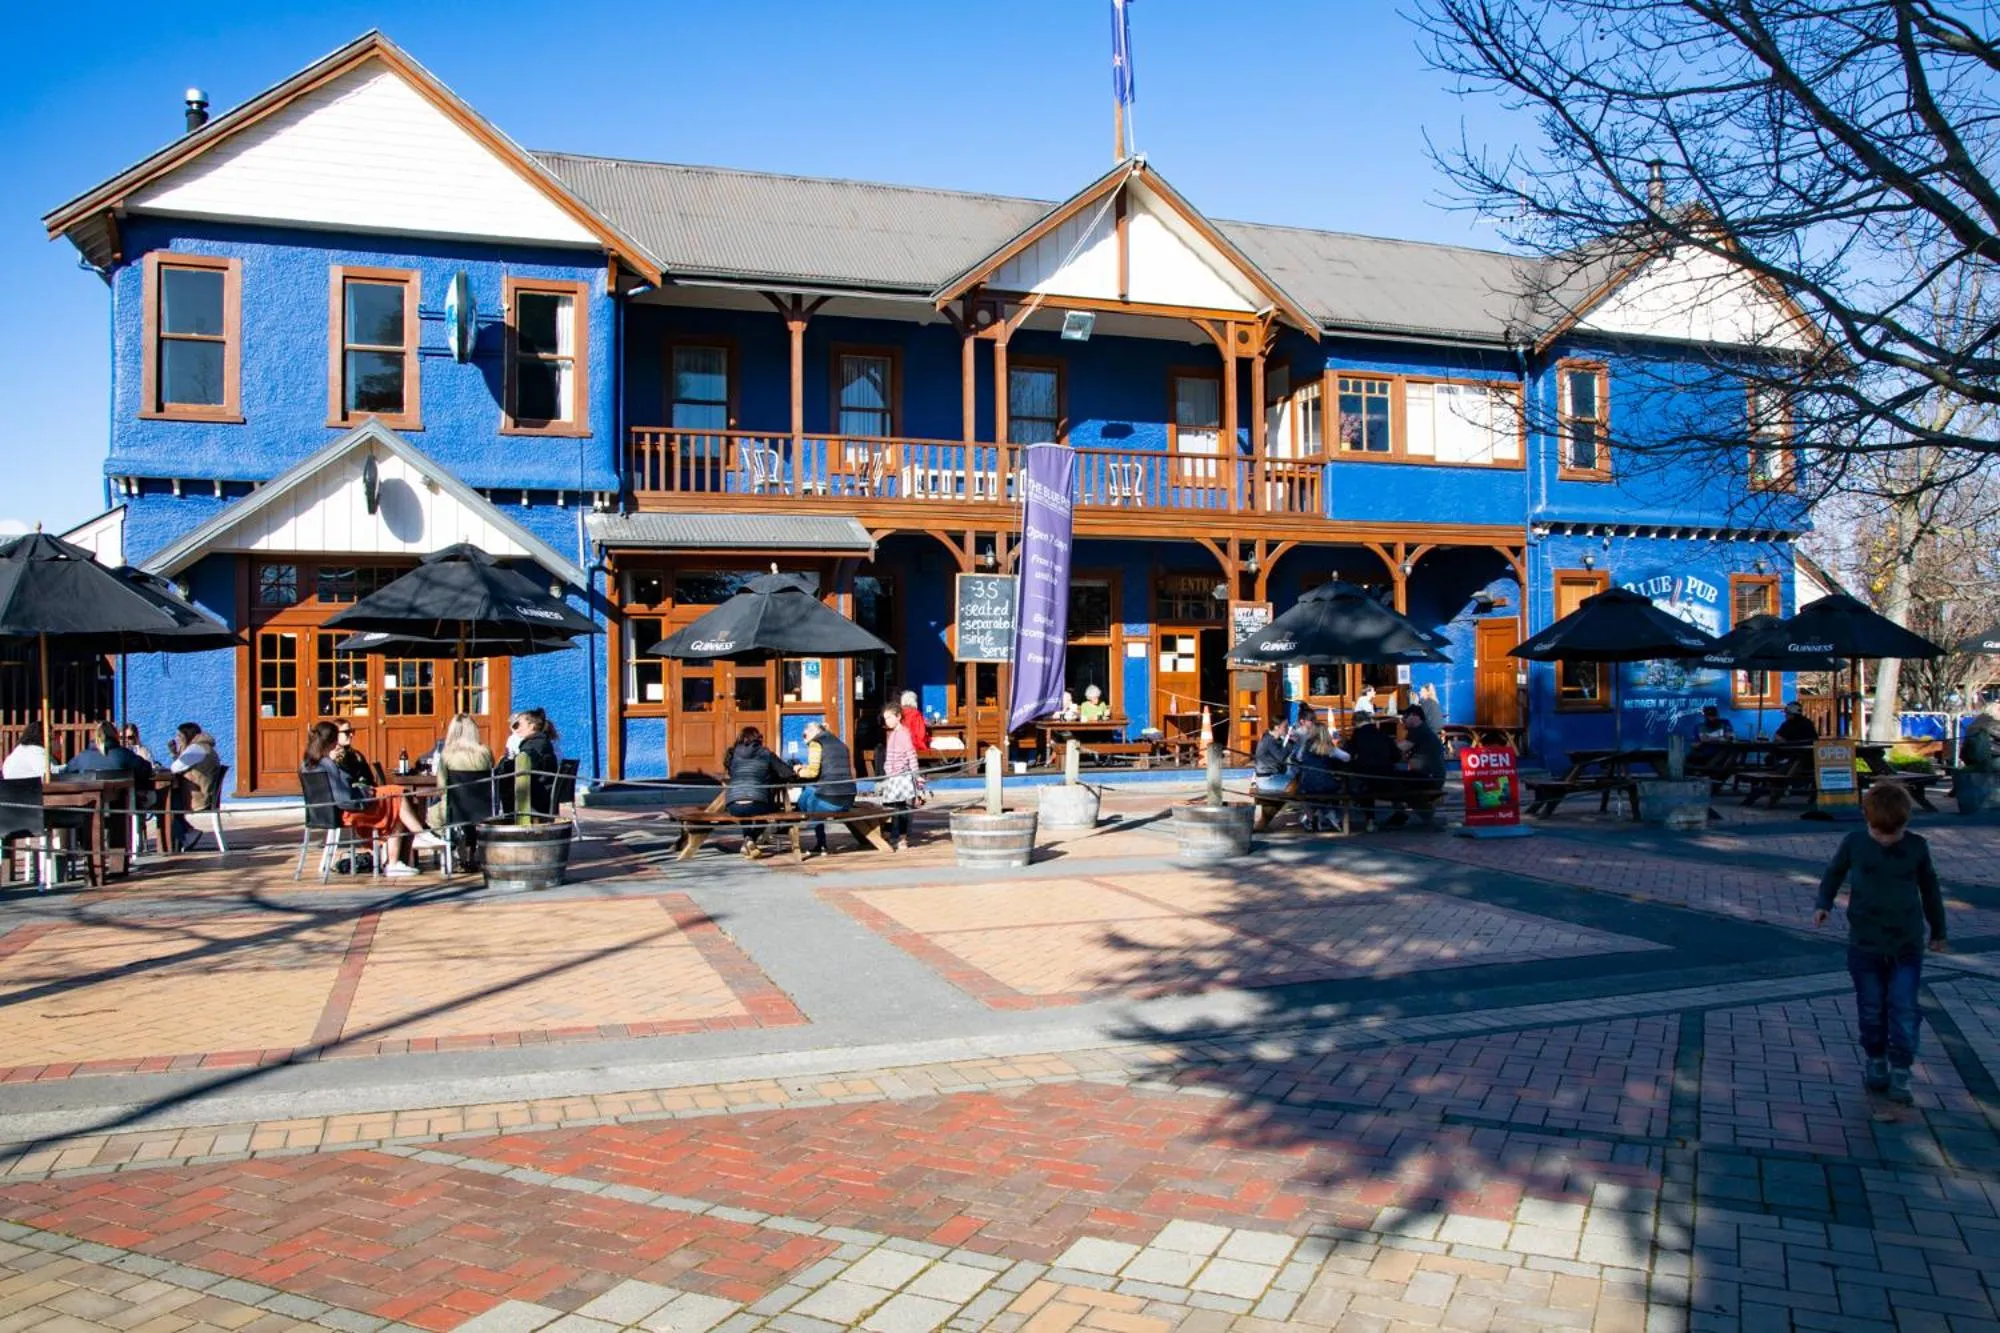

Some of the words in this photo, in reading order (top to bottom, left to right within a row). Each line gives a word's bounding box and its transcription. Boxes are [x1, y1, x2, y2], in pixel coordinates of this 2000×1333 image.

[1027, 525, 1049, 541] Open
[1685, 575, 1718, 604] PUB
[964, 600, 1009, 616] seated
[691, 640, 736, 651] GUINNESS
[1260, 641, 1298, 651] GUINNESS
[1788, 643, 1835, 653] GUINNESS
[1467, 752, 1511, 768] OPEN
[1817, 746, 1852, 760] OPEN
